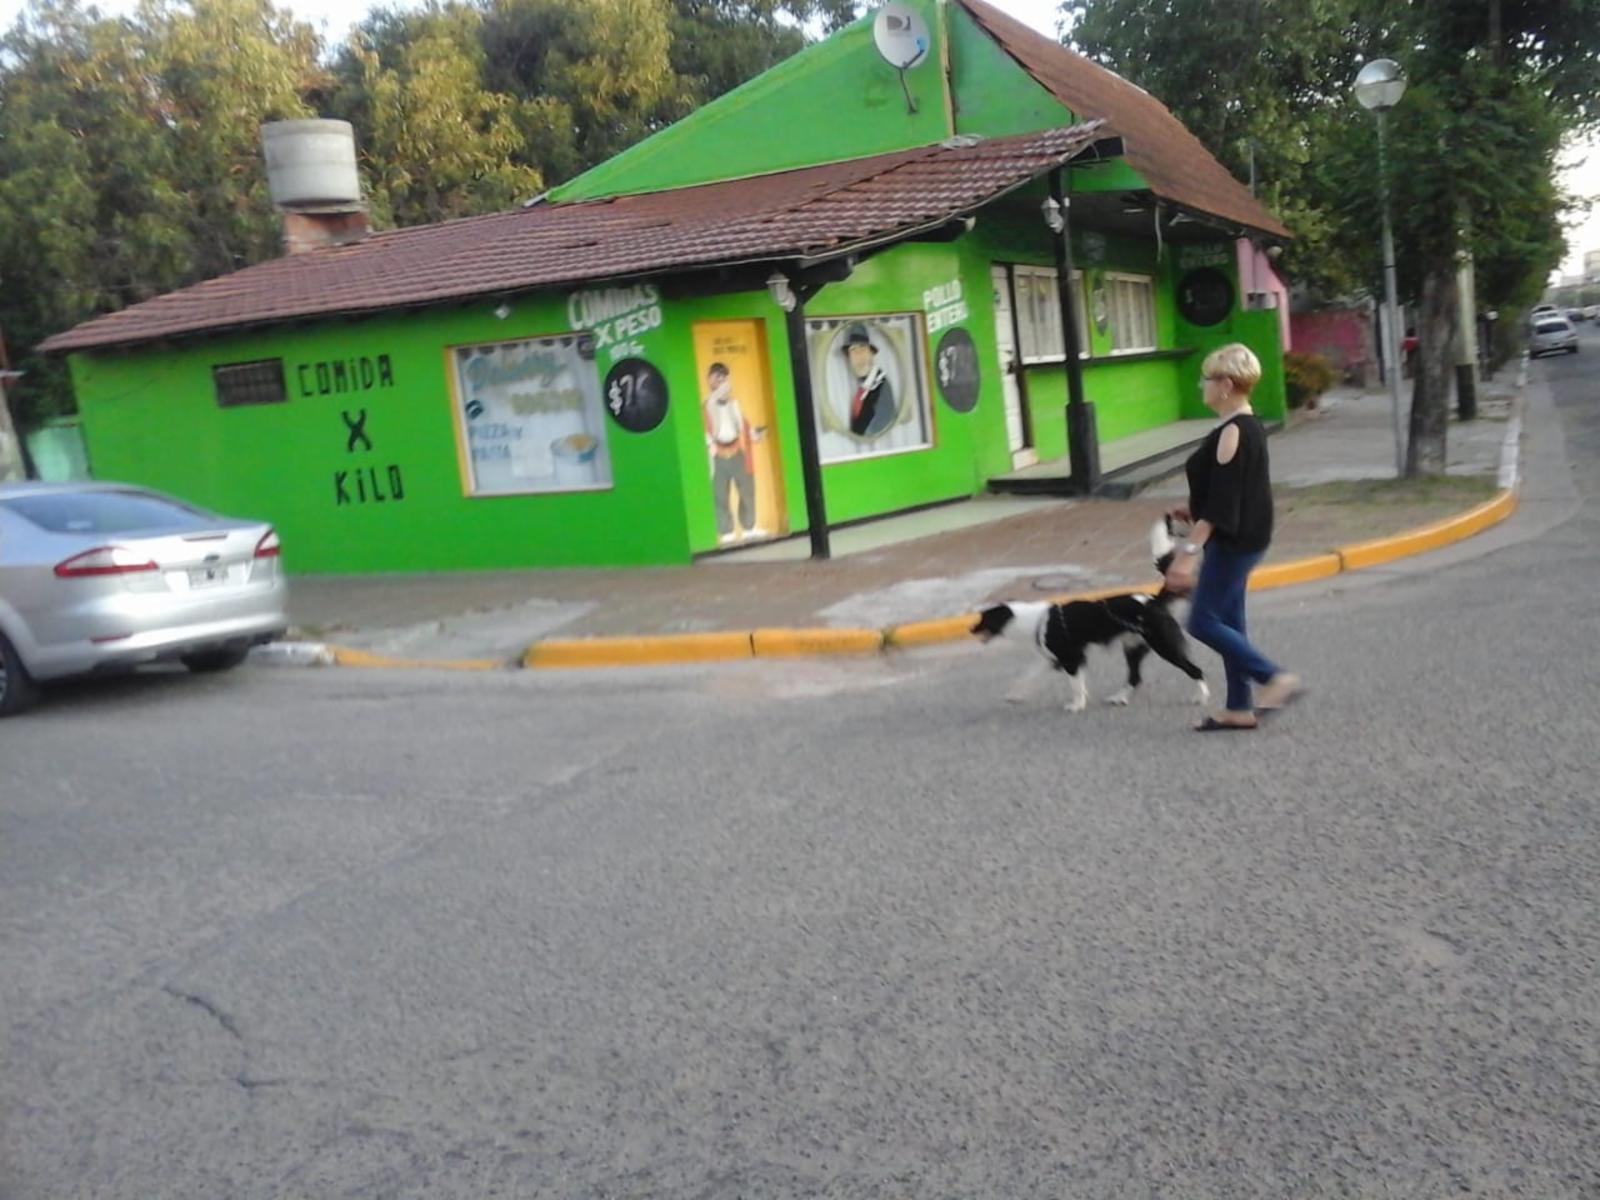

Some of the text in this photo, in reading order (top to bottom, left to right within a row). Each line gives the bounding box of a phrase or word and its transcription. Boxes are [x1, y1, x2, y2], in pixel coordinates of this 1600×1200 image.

[593, 305, 662, 350] X PESO
[342, 408, 373, 453] X
